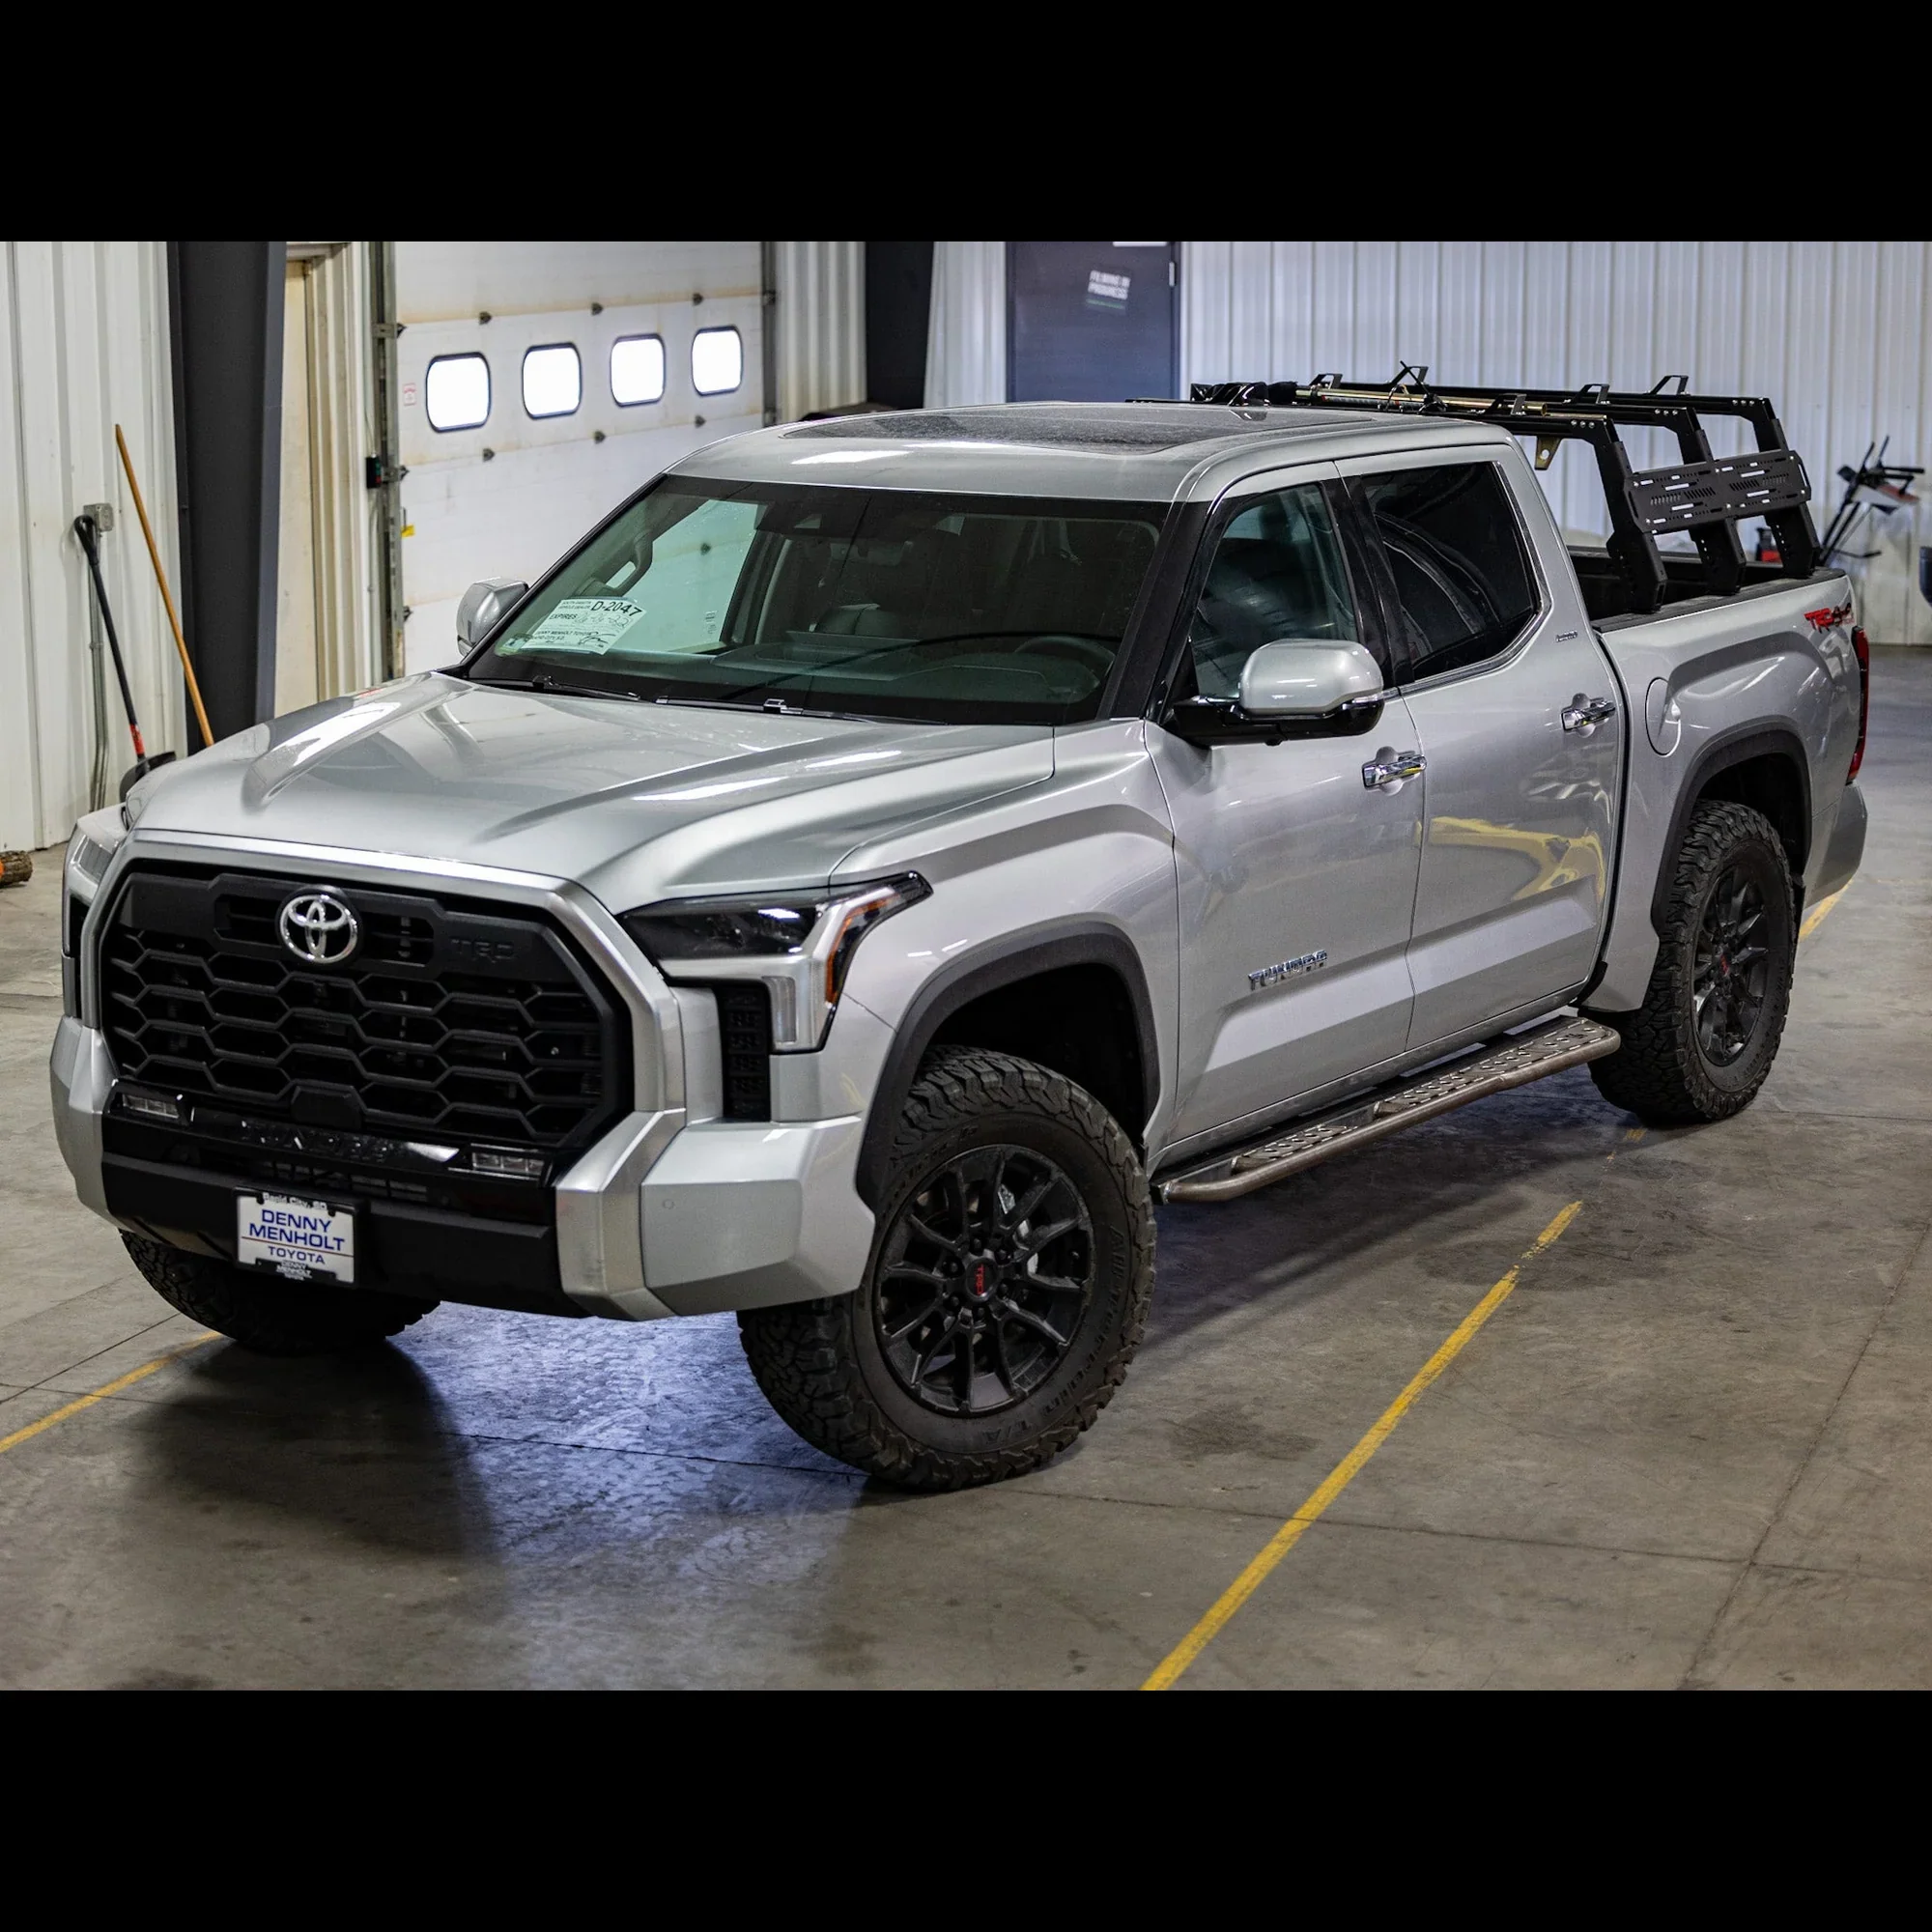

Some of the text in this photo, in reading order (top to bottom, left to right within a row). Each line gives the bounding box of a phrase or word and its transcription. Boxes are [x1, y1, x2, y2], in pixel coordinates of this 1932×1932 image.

[590, 600, 643, 617] D-2047
[1804, 608, 1833, 634] TRD
[448, 936, 514, 964] TRD
[262, 1209, 331, 1234] DENNY
[249, 1223, 345, 1251] MENHOLT
[268, 1245, 326, 1265] TOYOTA
